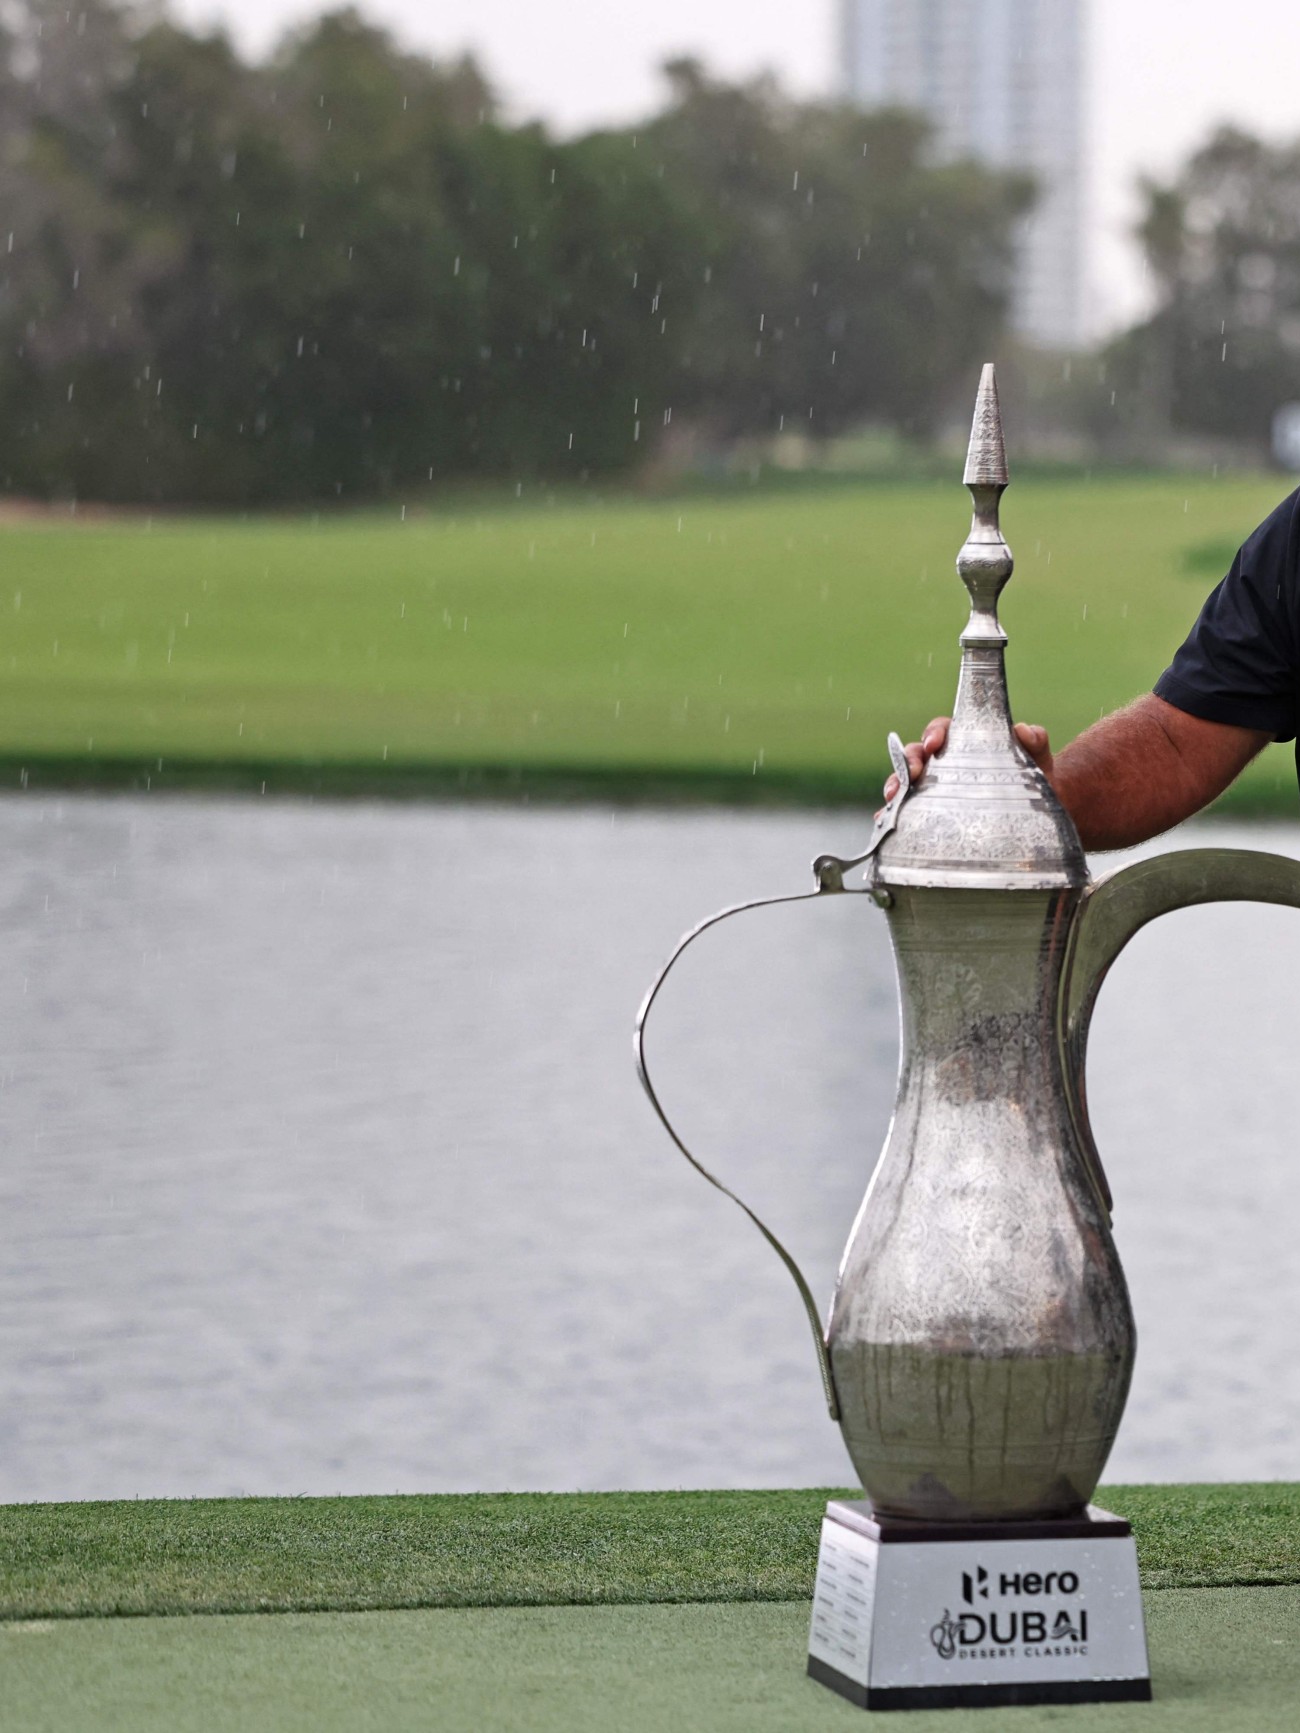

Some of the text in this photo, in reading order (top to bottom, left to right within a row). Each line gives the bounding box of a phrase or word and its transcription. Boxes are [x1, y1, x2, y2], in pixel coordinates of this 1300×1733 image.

[958, 1608, 1088, 1646] DUBAI
[958, 1645, 1089, 1661] DESERT CLASSIC
